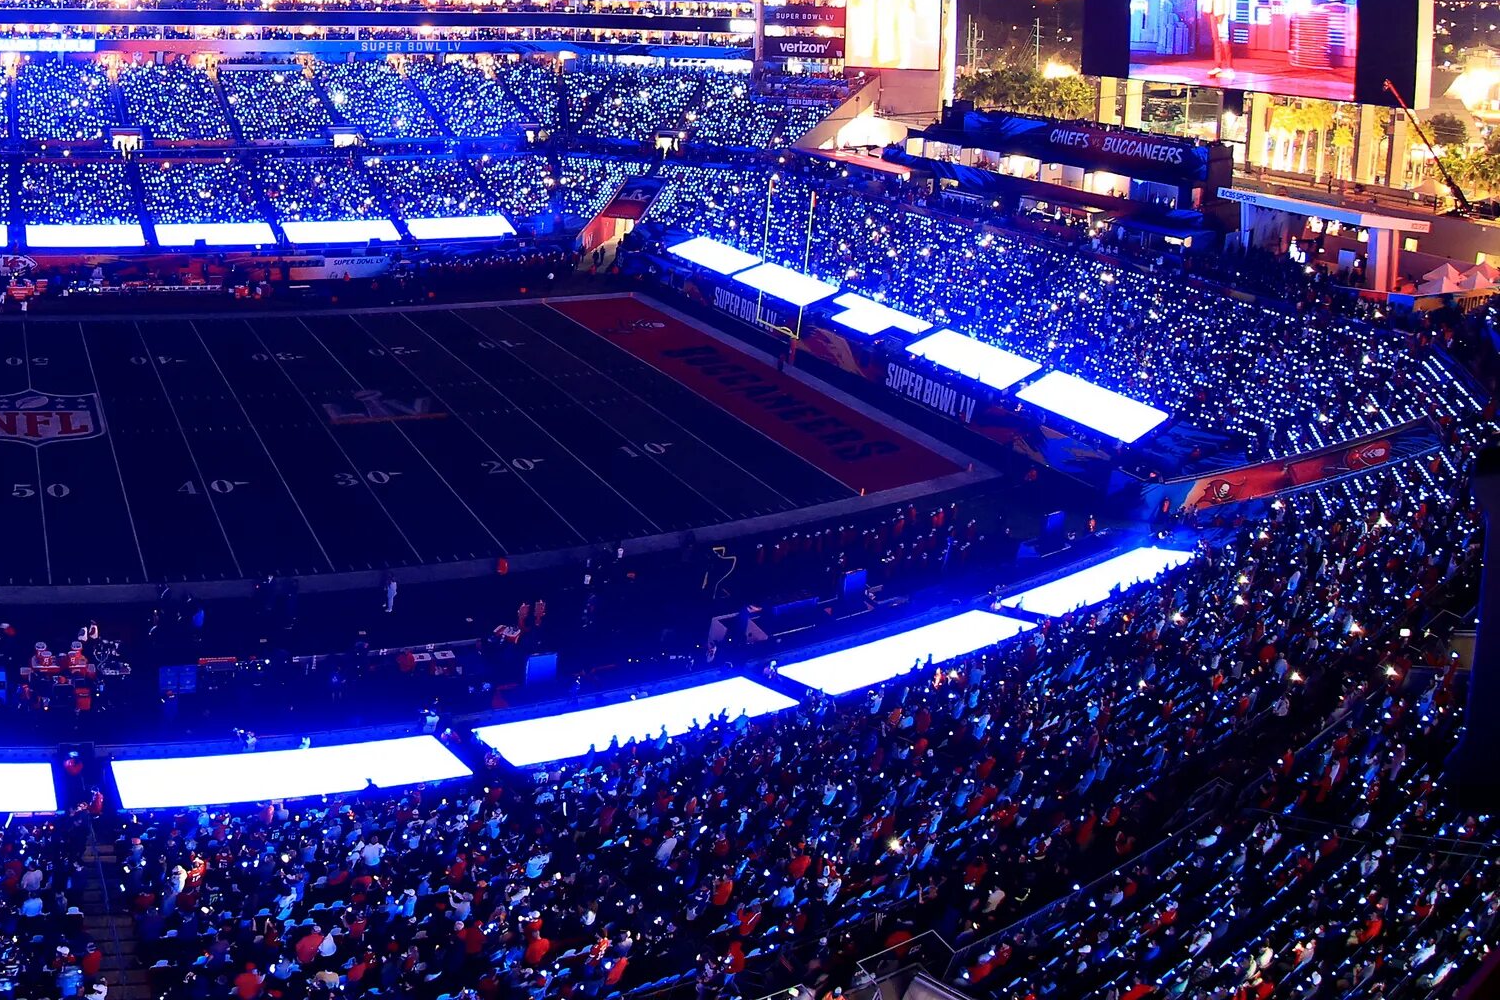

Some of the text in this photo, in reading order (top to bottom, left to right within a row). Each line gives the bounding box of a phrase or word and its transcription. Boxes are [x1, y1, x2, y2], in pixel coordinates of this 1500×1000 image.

[776, 12, 800, 20] SUPER
[361, 42, 461, 51] SUPER BOWL LV
[780, 41, 824, 53] verizon
[1050, 128, 1090, 148] CHIEFS
[1102, 136, 1183, 164] BUCCANEERS
[1225, 191, 1257, 203] CBS SPORTS
[713, 286, 740, 313] SUPER
[740, 296, 764, 325] BOWL
[885, 362, 922, 401] SUPER
[922, 377, 957, 417] BOWL
[662, 345, 900, 461] BUCCANEERS
[617, 442, 666, 458] 10
[480, 457, 535, 474] 20
[176, 479, 235, 494] 40
[332, 471, 391, 487] 30
[12, 483, 70, 497] 50
